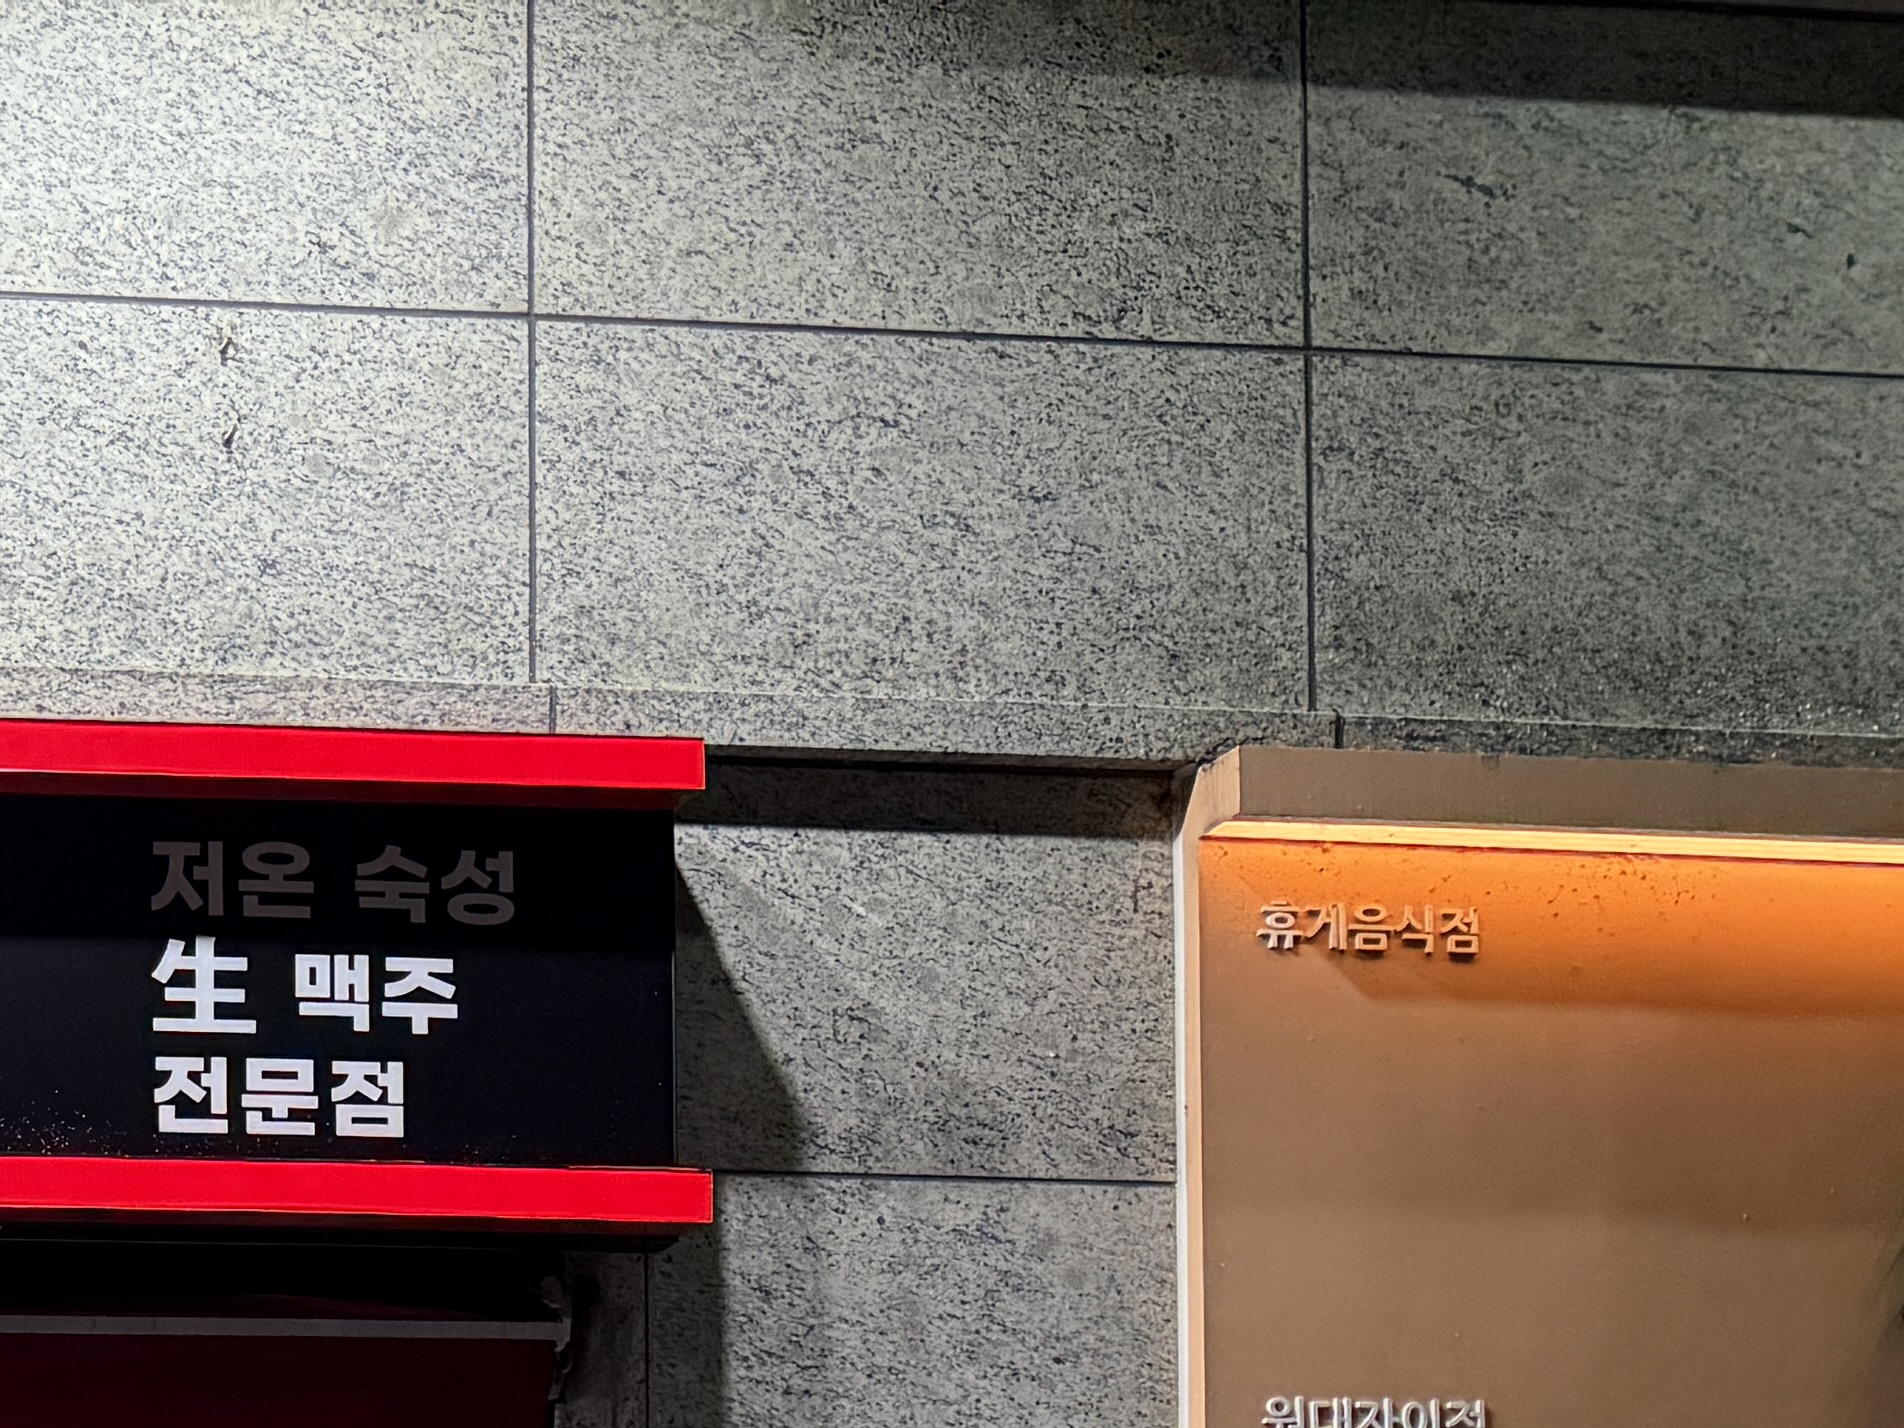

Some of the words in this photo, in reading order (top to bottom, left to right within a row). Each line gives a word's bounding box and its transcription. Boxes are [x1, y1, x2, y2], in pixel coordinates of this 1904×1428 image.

[151, 841, 315, 918] 저온
[354, 845, 515, 926] 숙성
[1257, 900, 1480, 956] 휴게음식점
[151, 937, 257, 1034] 生
[294, 954, 458, 1035] 맥주
[153, 1056, 404, 1138] 전문점
